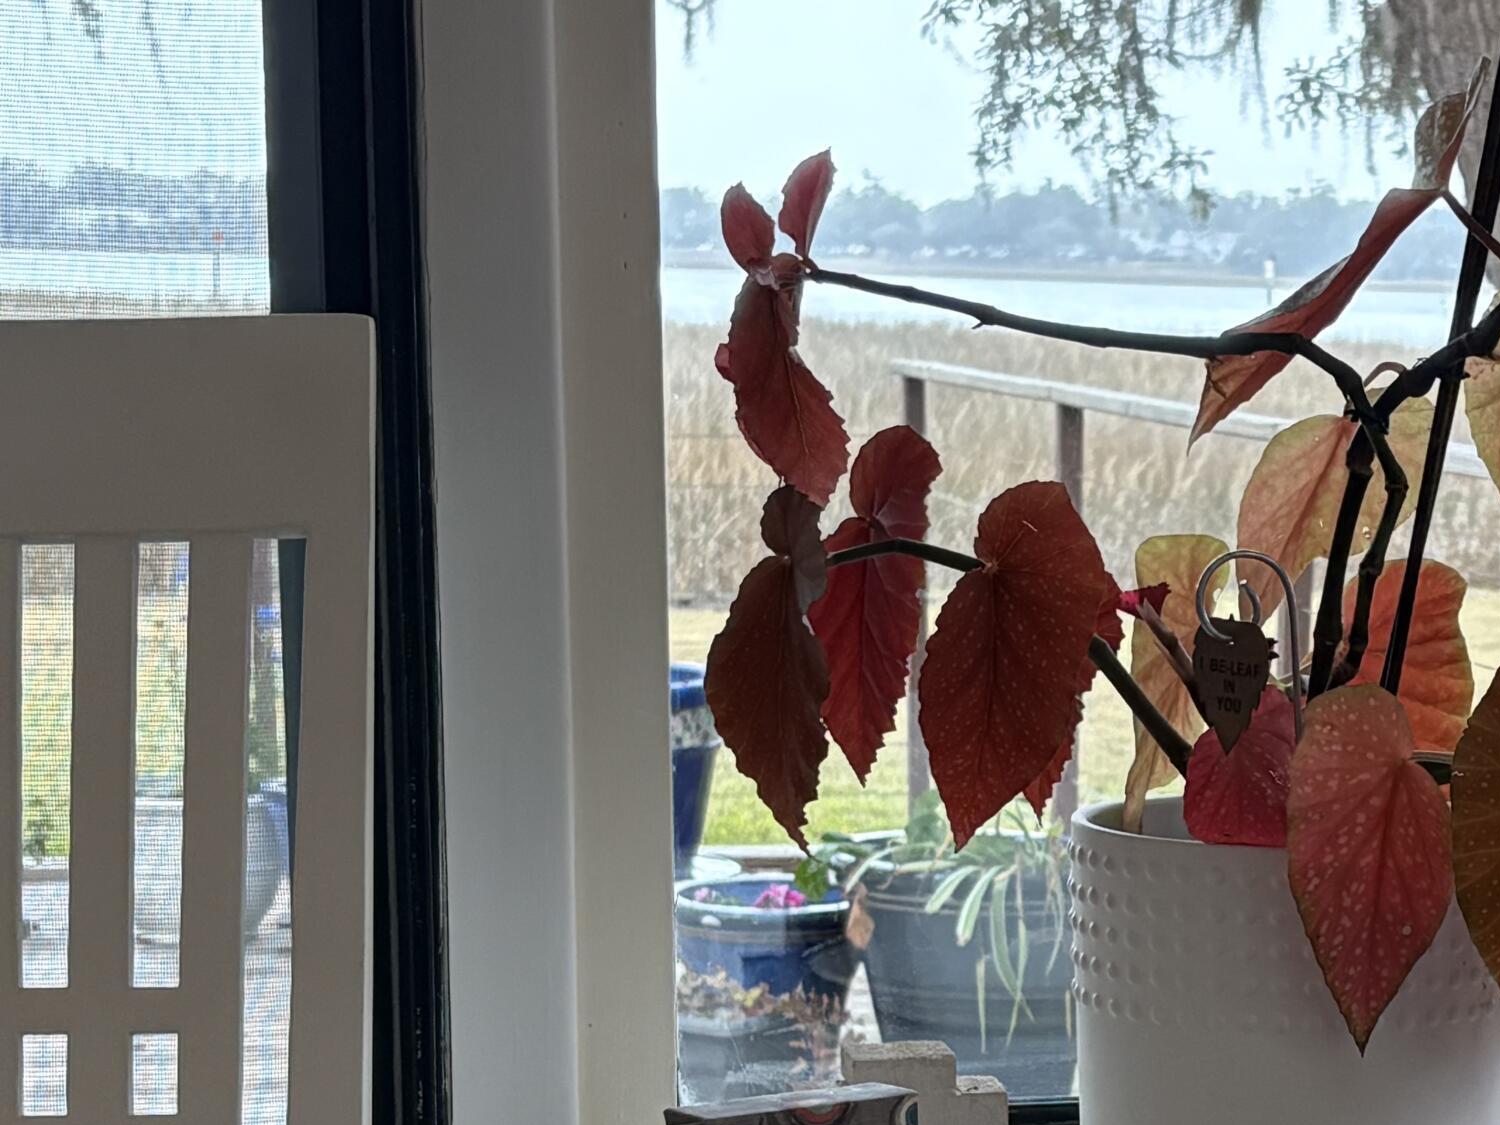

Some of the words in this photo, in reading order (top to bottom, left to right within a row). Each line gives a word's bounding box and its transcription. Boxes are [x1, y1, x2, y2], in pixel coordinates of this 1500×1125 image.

[1210, 658, 1261, 678] BE-LEAF
[1224, 679, 1236, 695] IN
[1217, 697, 1243, 714] YOU
